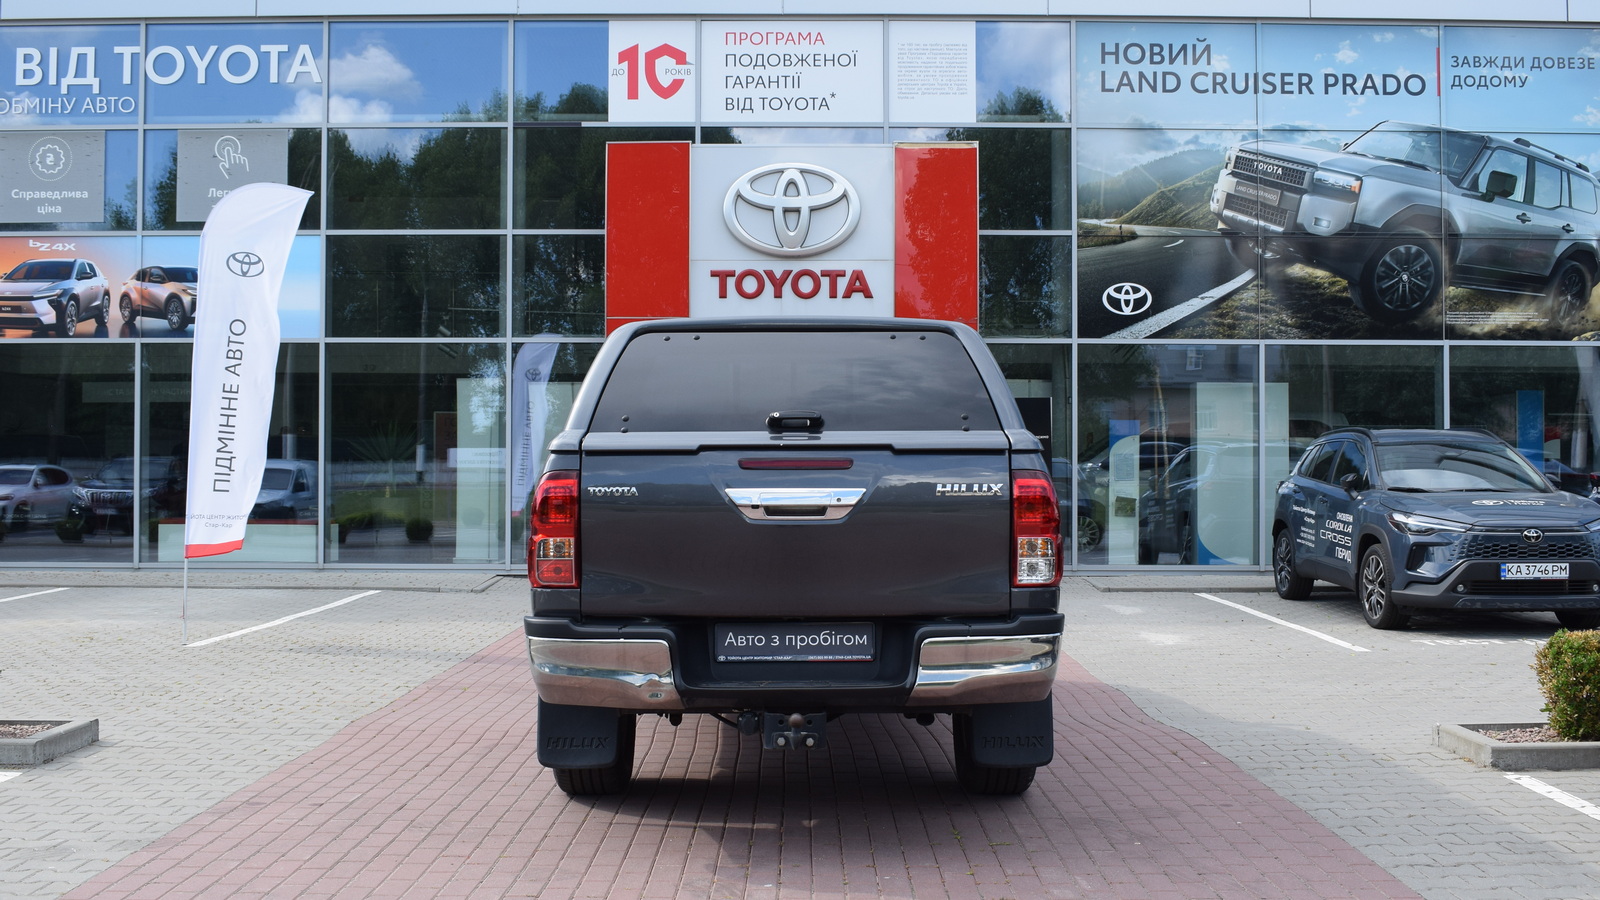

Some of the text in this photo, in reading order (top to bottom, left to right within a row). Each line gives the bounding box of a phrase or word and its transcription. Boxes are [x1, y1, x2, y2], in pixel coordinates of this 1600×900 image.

[725, 32, 825, 46] ПРОГРАМА
[1100, 37, 1211, 65] НОВИЙ
[725, 50, 858, 70] ПОДОВЖЕНОЇ
[1451, 56, 1595, 71] ЗАВЖДИ ДОВЕЗЕ
[15, 45, 322, 94] ВІД TOYOTA
[612, 69, 625, 77] ДО
[725, 72, 802, 89] ГАРАНТІЇ
[1100, 71, 1426, 96] LAND CRUISER PRADO
[1451, 75, 1528, 90] ДОДОМУ
[0, 96, 135, 114] ОБМІНУ АВТО
[725, 97, 753, 113] ВІД
[1253, 162, 1282, 175] TOYOTA
[11, 189, 88, 200] Справедлива
[207, 188, 231, 198] Лег
[37, 203, 62, 214] ціна
[710, 268, 874, 300] TOYOTA
[213, 318, 247, 493] ПІДМІННЕ АВТО
[587, 486, 639, 497] TOYOTA
[935, 483, 1004, 496] HILUX
[1325, 519, 1353, 534] COROLLA
[1320, 529, 1352, 547] CROSS
[1507, 565, 1568, 575] KA 3746 PM
[724, 630, 868, 650] Авто з пробігом
[546, 736, 610, 749] HILUX
[982, 735, 1045, 748] HILUX
